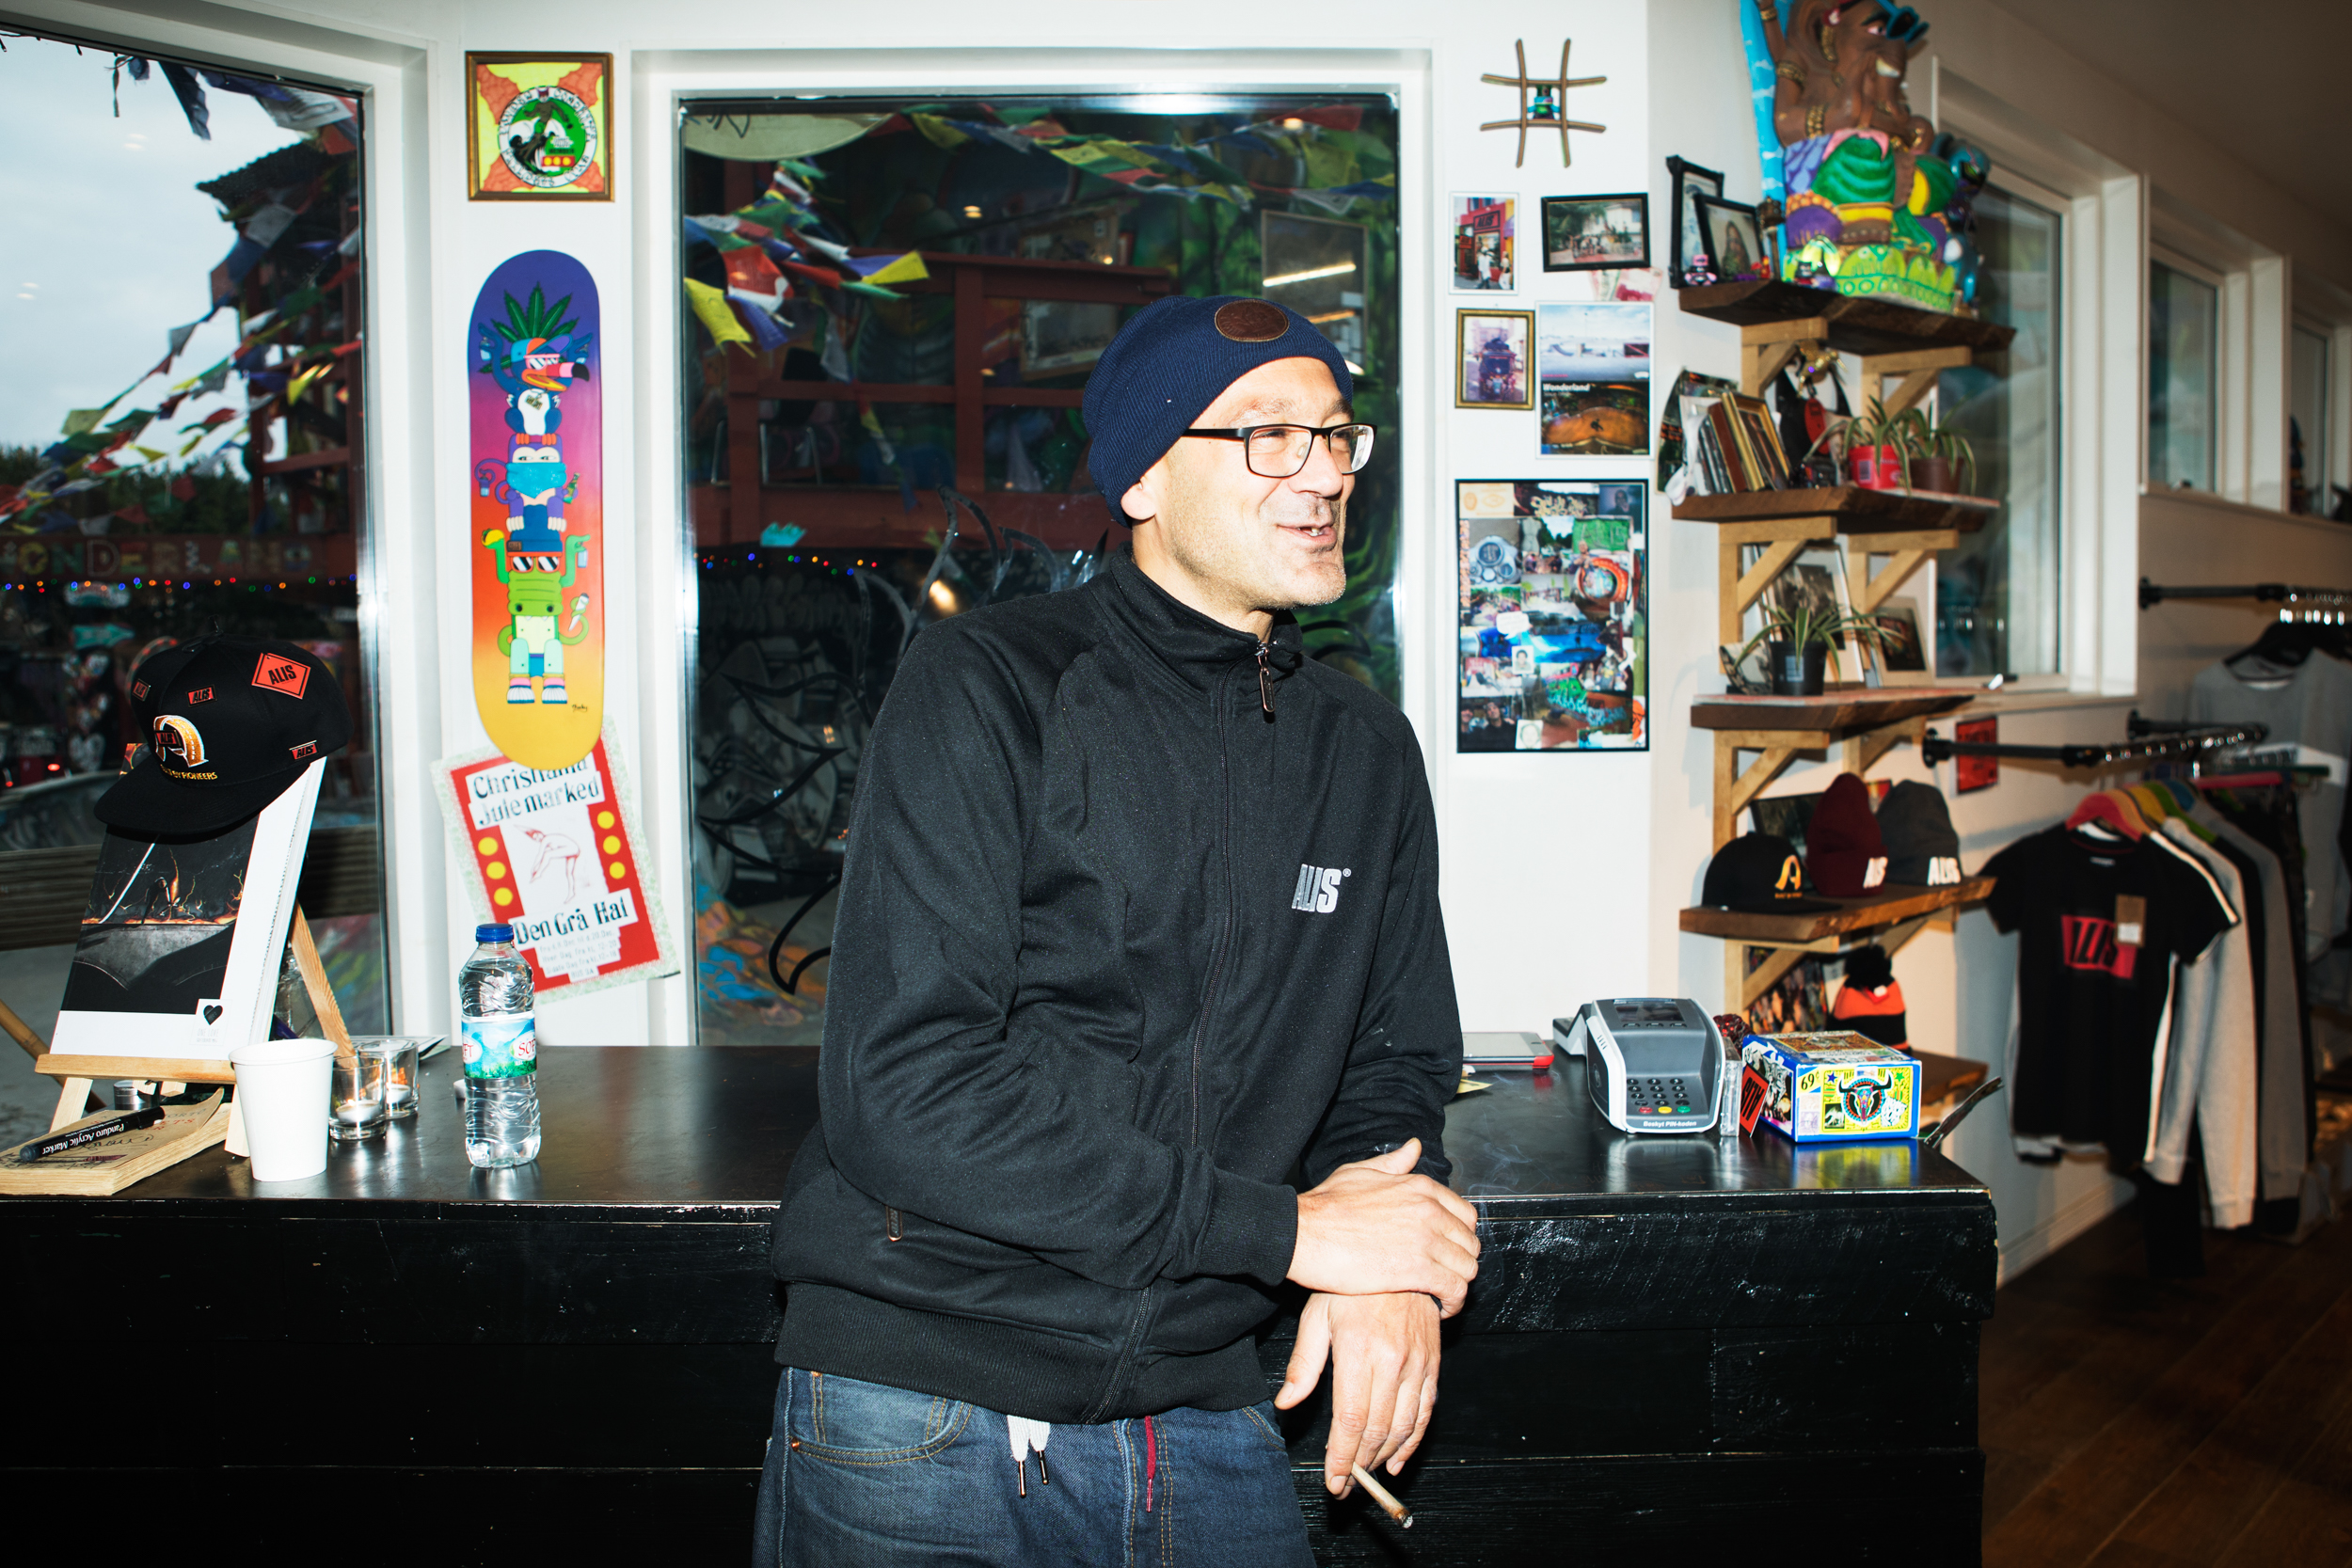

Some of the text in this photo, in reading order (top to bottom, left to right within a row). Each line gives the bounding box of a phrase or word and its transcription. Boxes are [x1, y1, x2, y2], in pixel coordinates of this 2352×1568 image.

[268, 664, 296, 685] ALIS
[192, 688, 211, 704] ALIS
[513, 921, 551, 944] Den
[554, 909, 589, 936] Grå
[69, 1130, 94, 1147] Acrylic
[95, 1122, 125, 1138] Panduro
[42, 1138, 69, 1155] Marker
